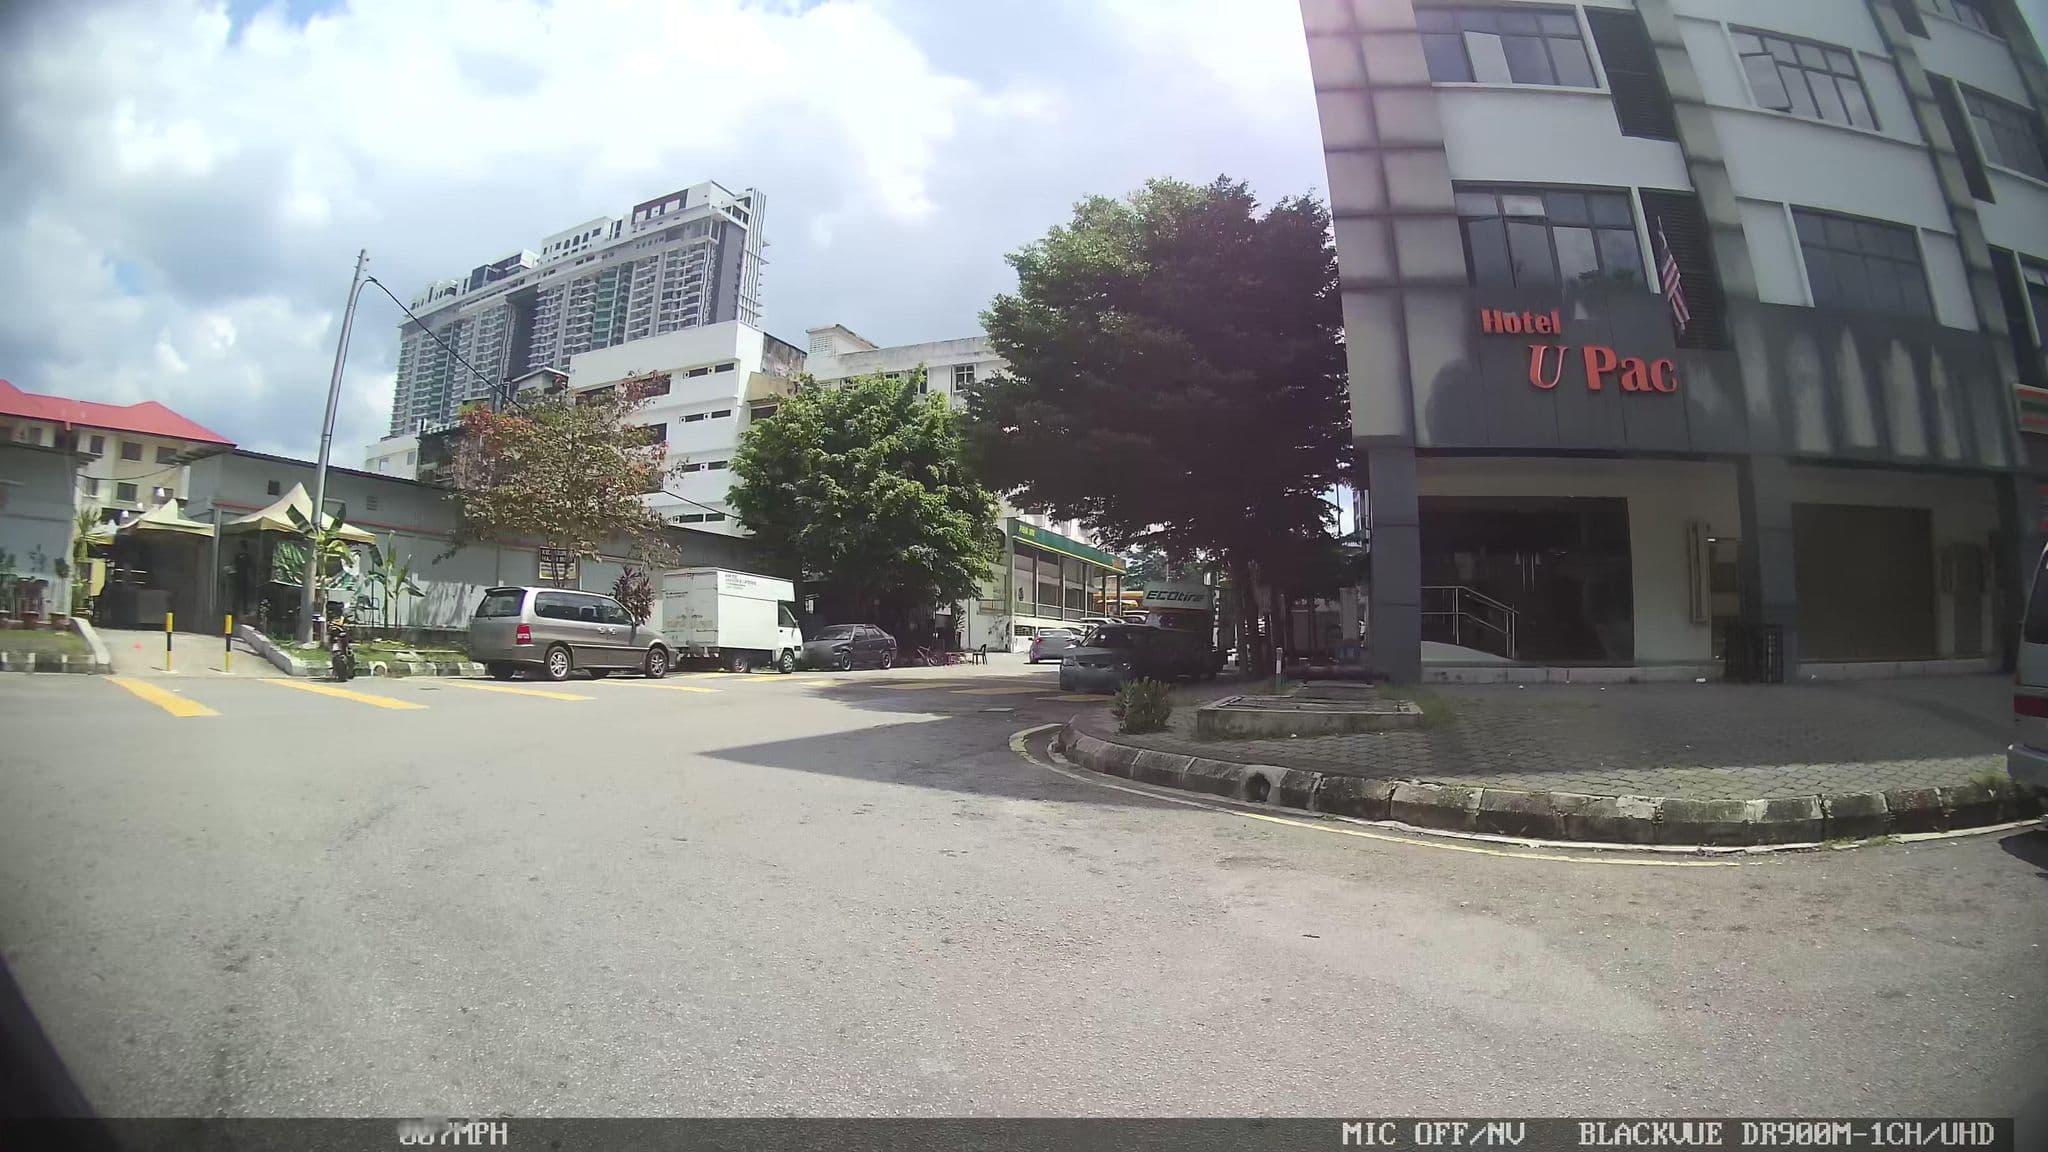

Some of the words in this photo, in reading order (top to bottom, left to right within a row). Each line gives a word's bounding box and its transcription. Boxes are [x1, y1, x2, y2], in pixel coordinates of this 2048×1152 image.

[1480, 308, 1562, 334] Hotel
[1527, 344, 1569, 389] U
[1583, 345, 1678, 393] Pac
